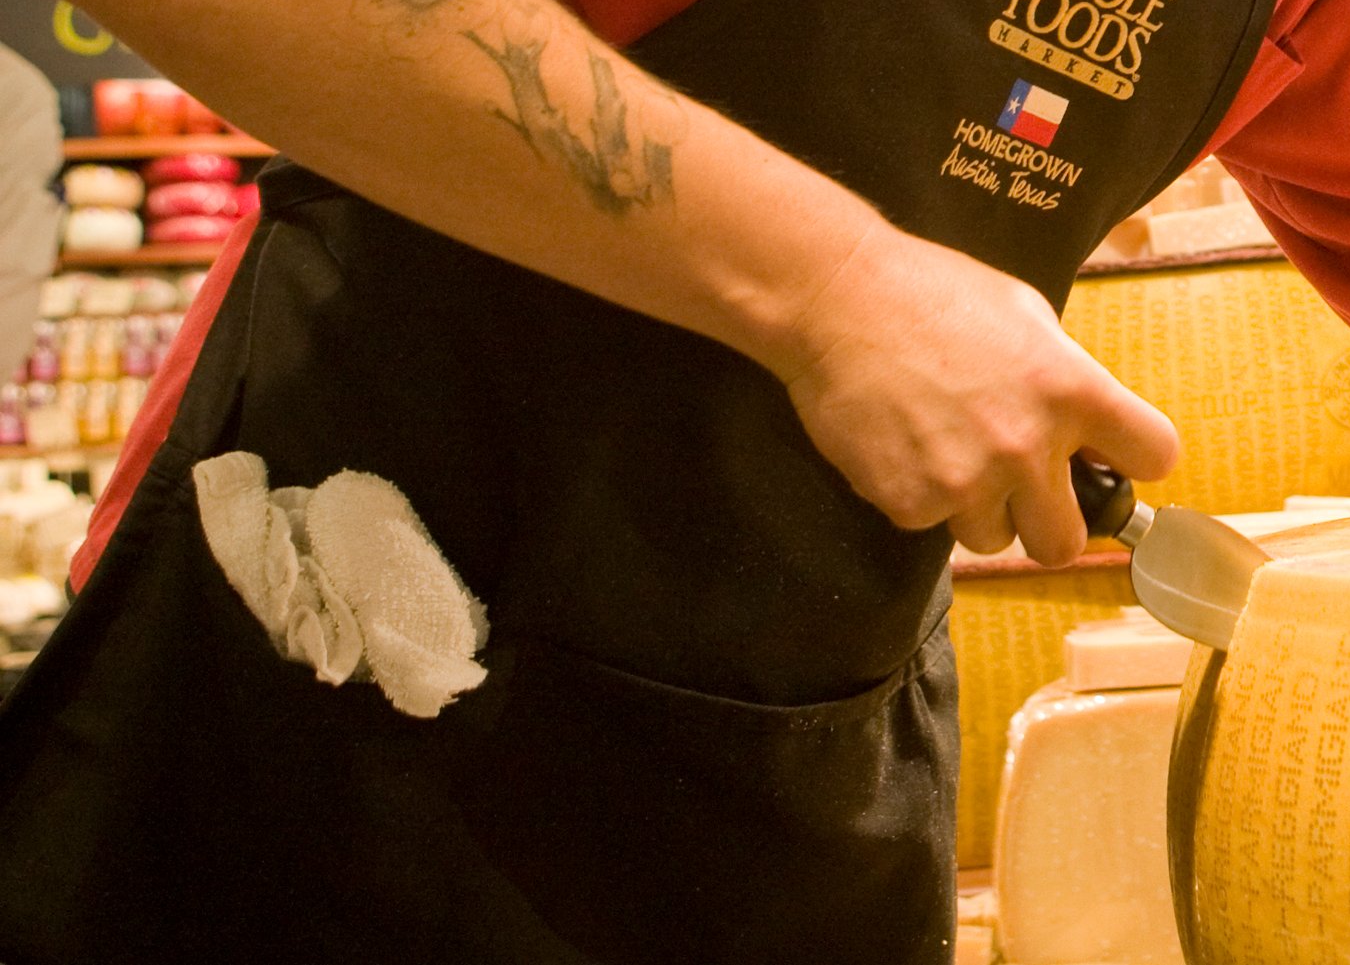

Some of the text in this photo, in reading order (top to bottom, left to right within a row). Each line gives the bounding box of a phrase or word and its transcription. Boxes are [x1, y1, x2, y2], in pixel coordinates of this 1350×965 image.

[998, 24, 1126, 95] MARKET
[940, 143, 1061, 211] Austin, Texas
[953, 119, 1083, 187] HOMEGROWN
